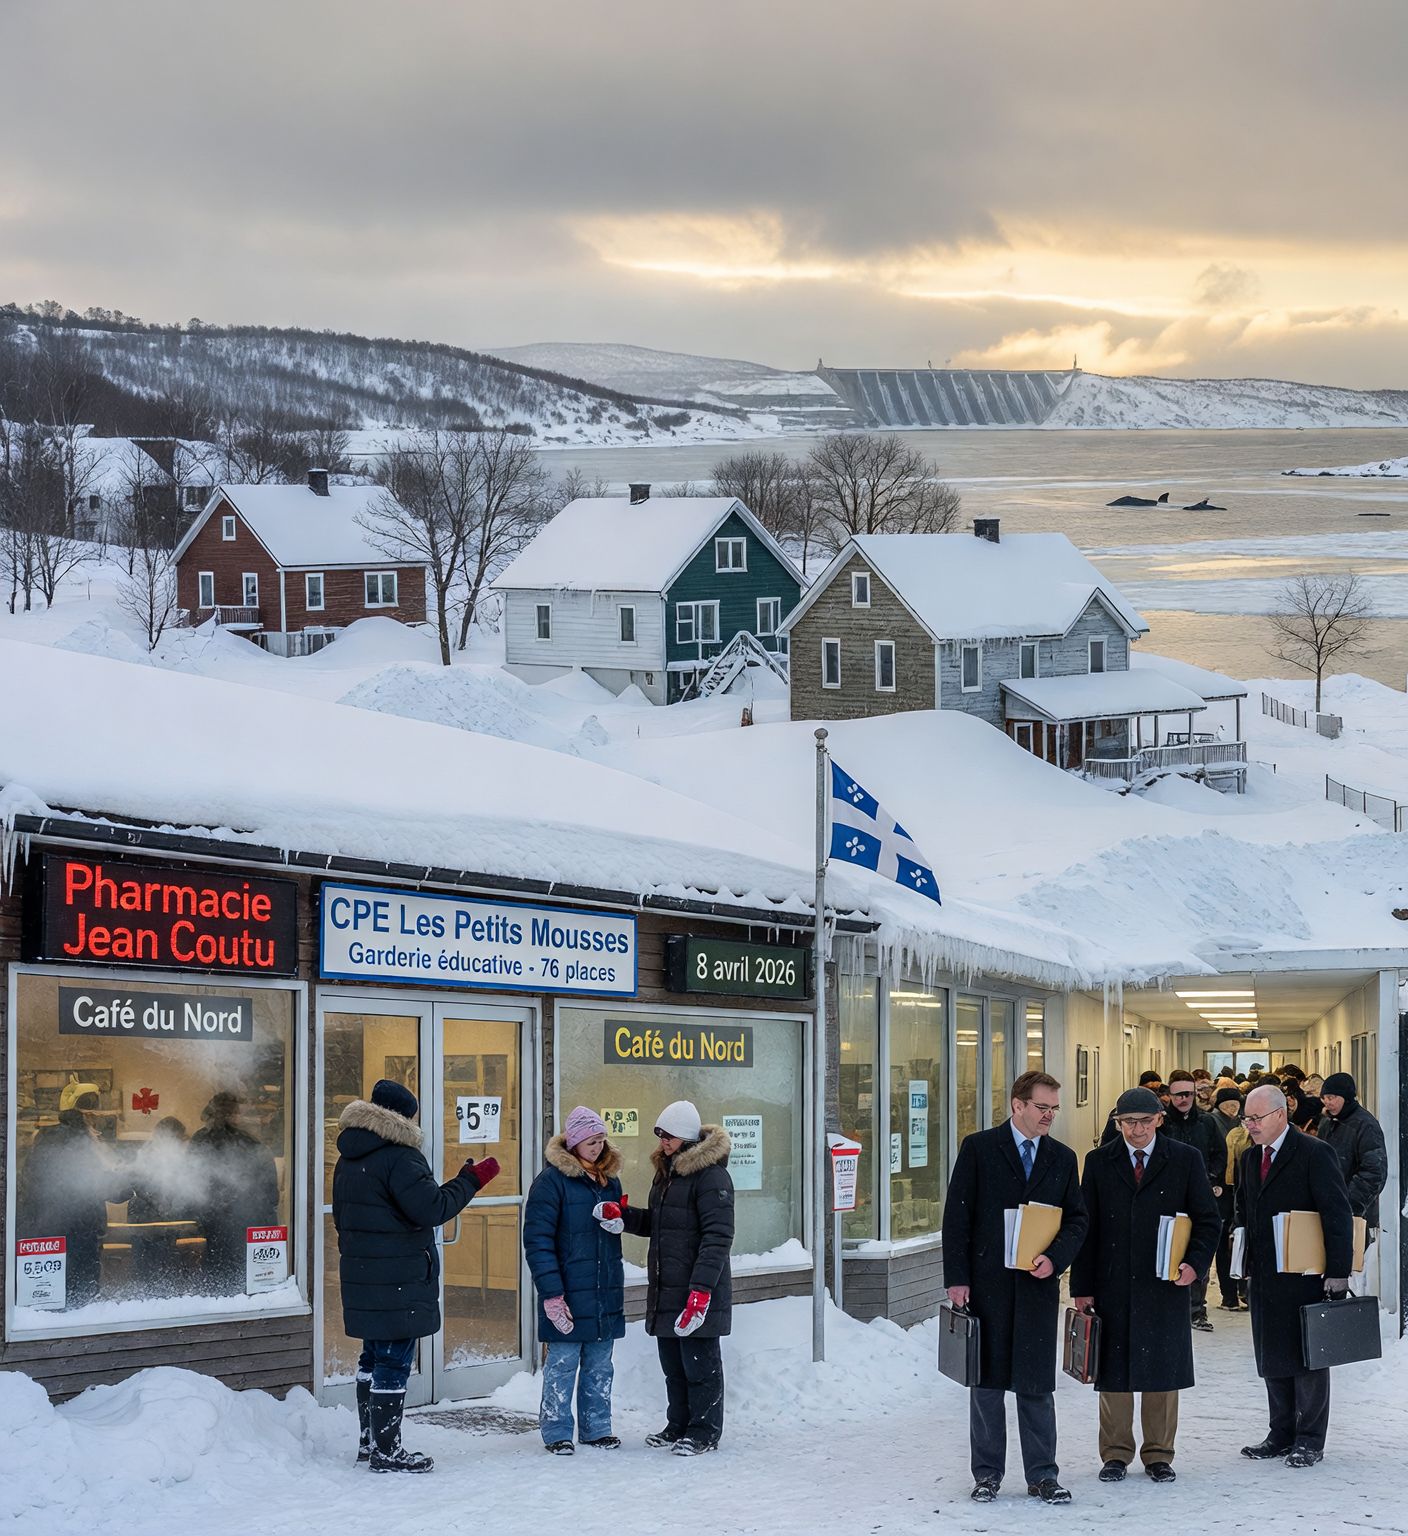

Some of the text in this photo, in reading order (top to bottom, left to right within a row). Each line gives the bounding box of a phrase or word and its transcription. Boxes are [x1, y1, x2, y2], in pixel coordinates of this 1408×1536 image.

[65, 862, 272, 922] Pharmacie
[63, 913, 275, 967] Jean Coutu
[330, 897, 629, 954] CPE Les Petits Mousses
[349, 941, 432, 969] Garderie
[438, 950, 523, 976] éducative
[541, 958, 559, 979] 76
[565, 960, 616, 984] places
[696, 953, 796, 985] 8 avril 2026
[73, 996, 242, 1033] Café du Nord
[614, 1026, 745, 1062] Café du Nord
